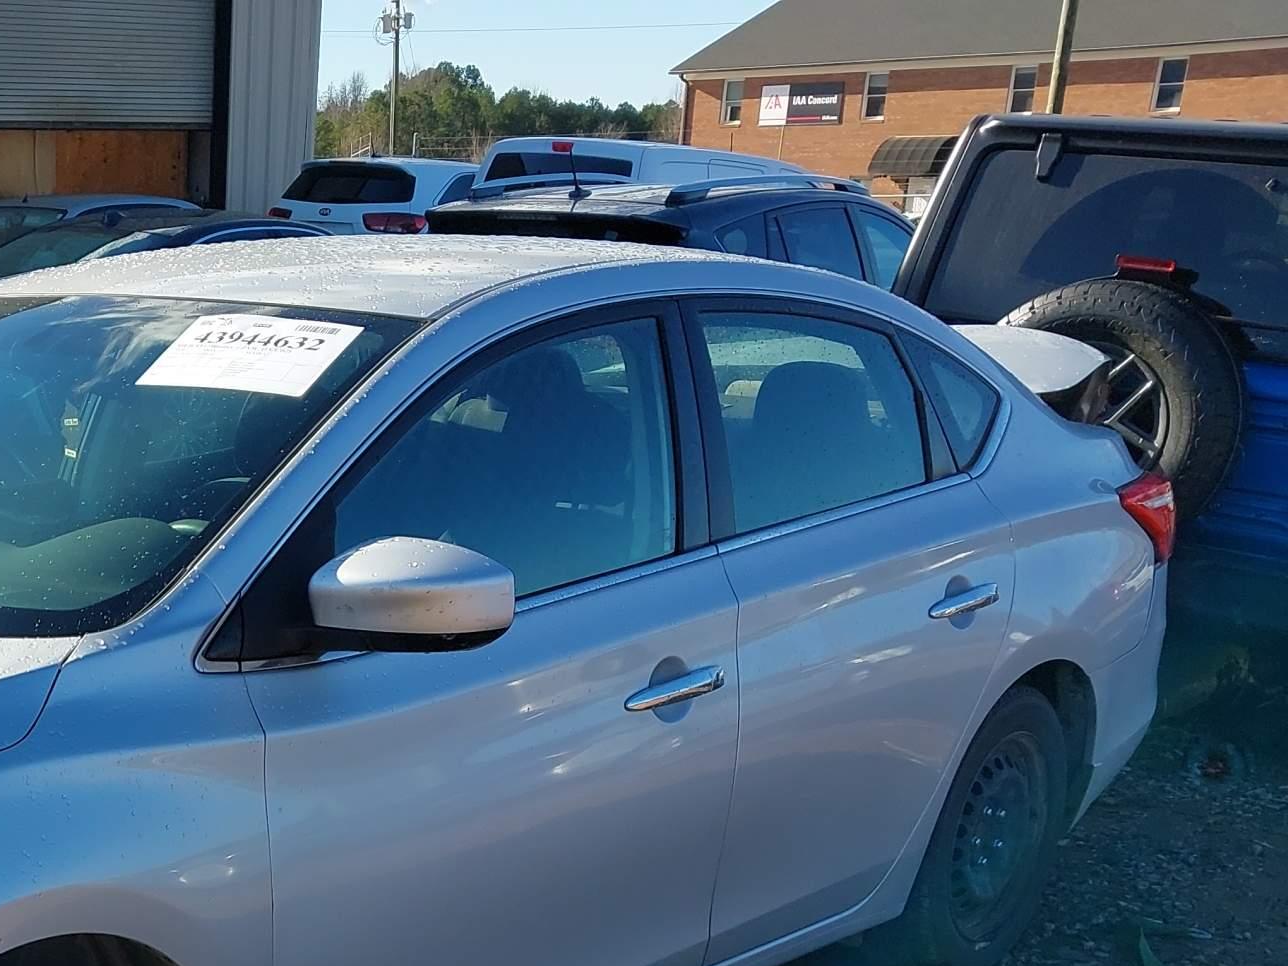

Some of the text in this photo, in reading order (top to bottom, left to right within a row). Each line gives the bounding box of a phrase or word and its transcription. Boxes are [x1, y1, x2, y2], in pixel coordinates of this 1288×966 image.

[792, 94, 838, 105] IAA Concord
[193, 330, 327, 352] 43944632
